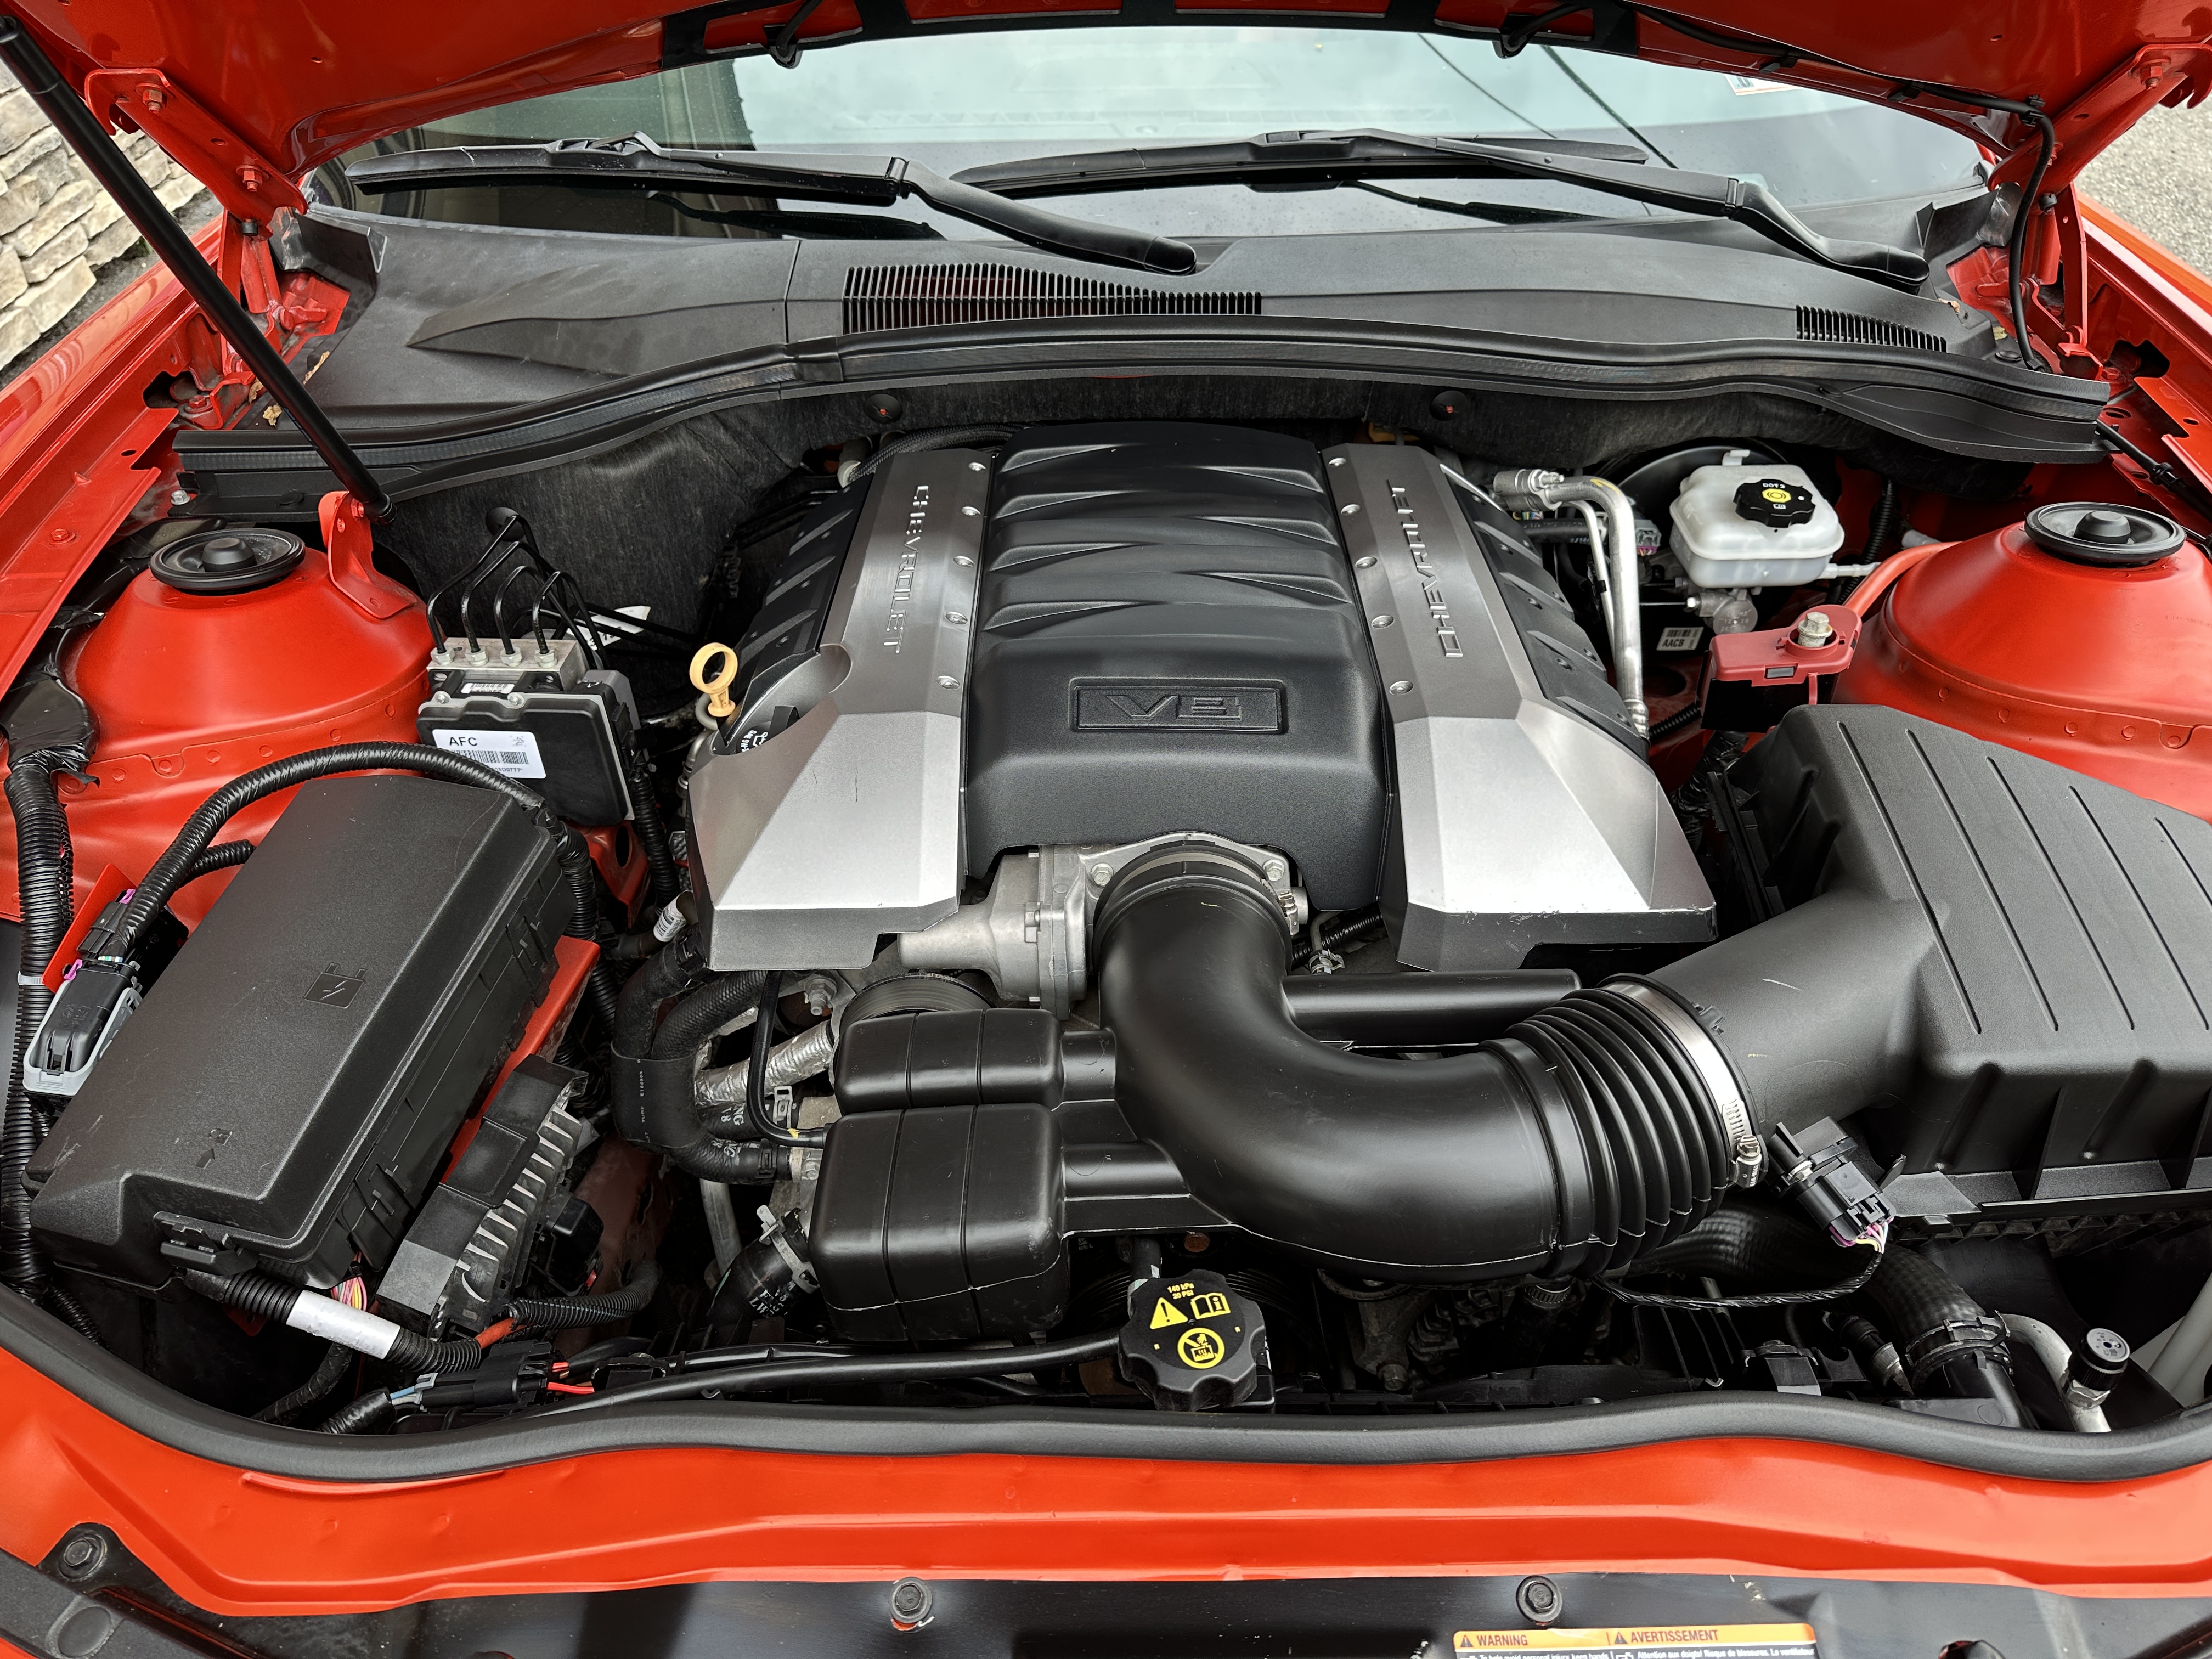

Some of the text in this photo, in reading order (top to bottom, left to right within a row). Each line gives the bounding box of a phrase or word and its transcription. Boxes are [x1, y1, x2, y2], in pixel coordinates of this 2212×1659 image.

[883, 485, 930, 654] CHEVROLET
[1386, 479, 1463, 658] CHEVROLET
[1103, 694, 1242, 720] V8
[744, 730, 757, 739] SAE
[449, 737, 478, 746] AFC
[1167, 1285, 1181, 1293] 140
[1476, 1635, 1528, 1646] WARNING
[1630, 1629, 1719, 1643] AVERTISSEMENT
